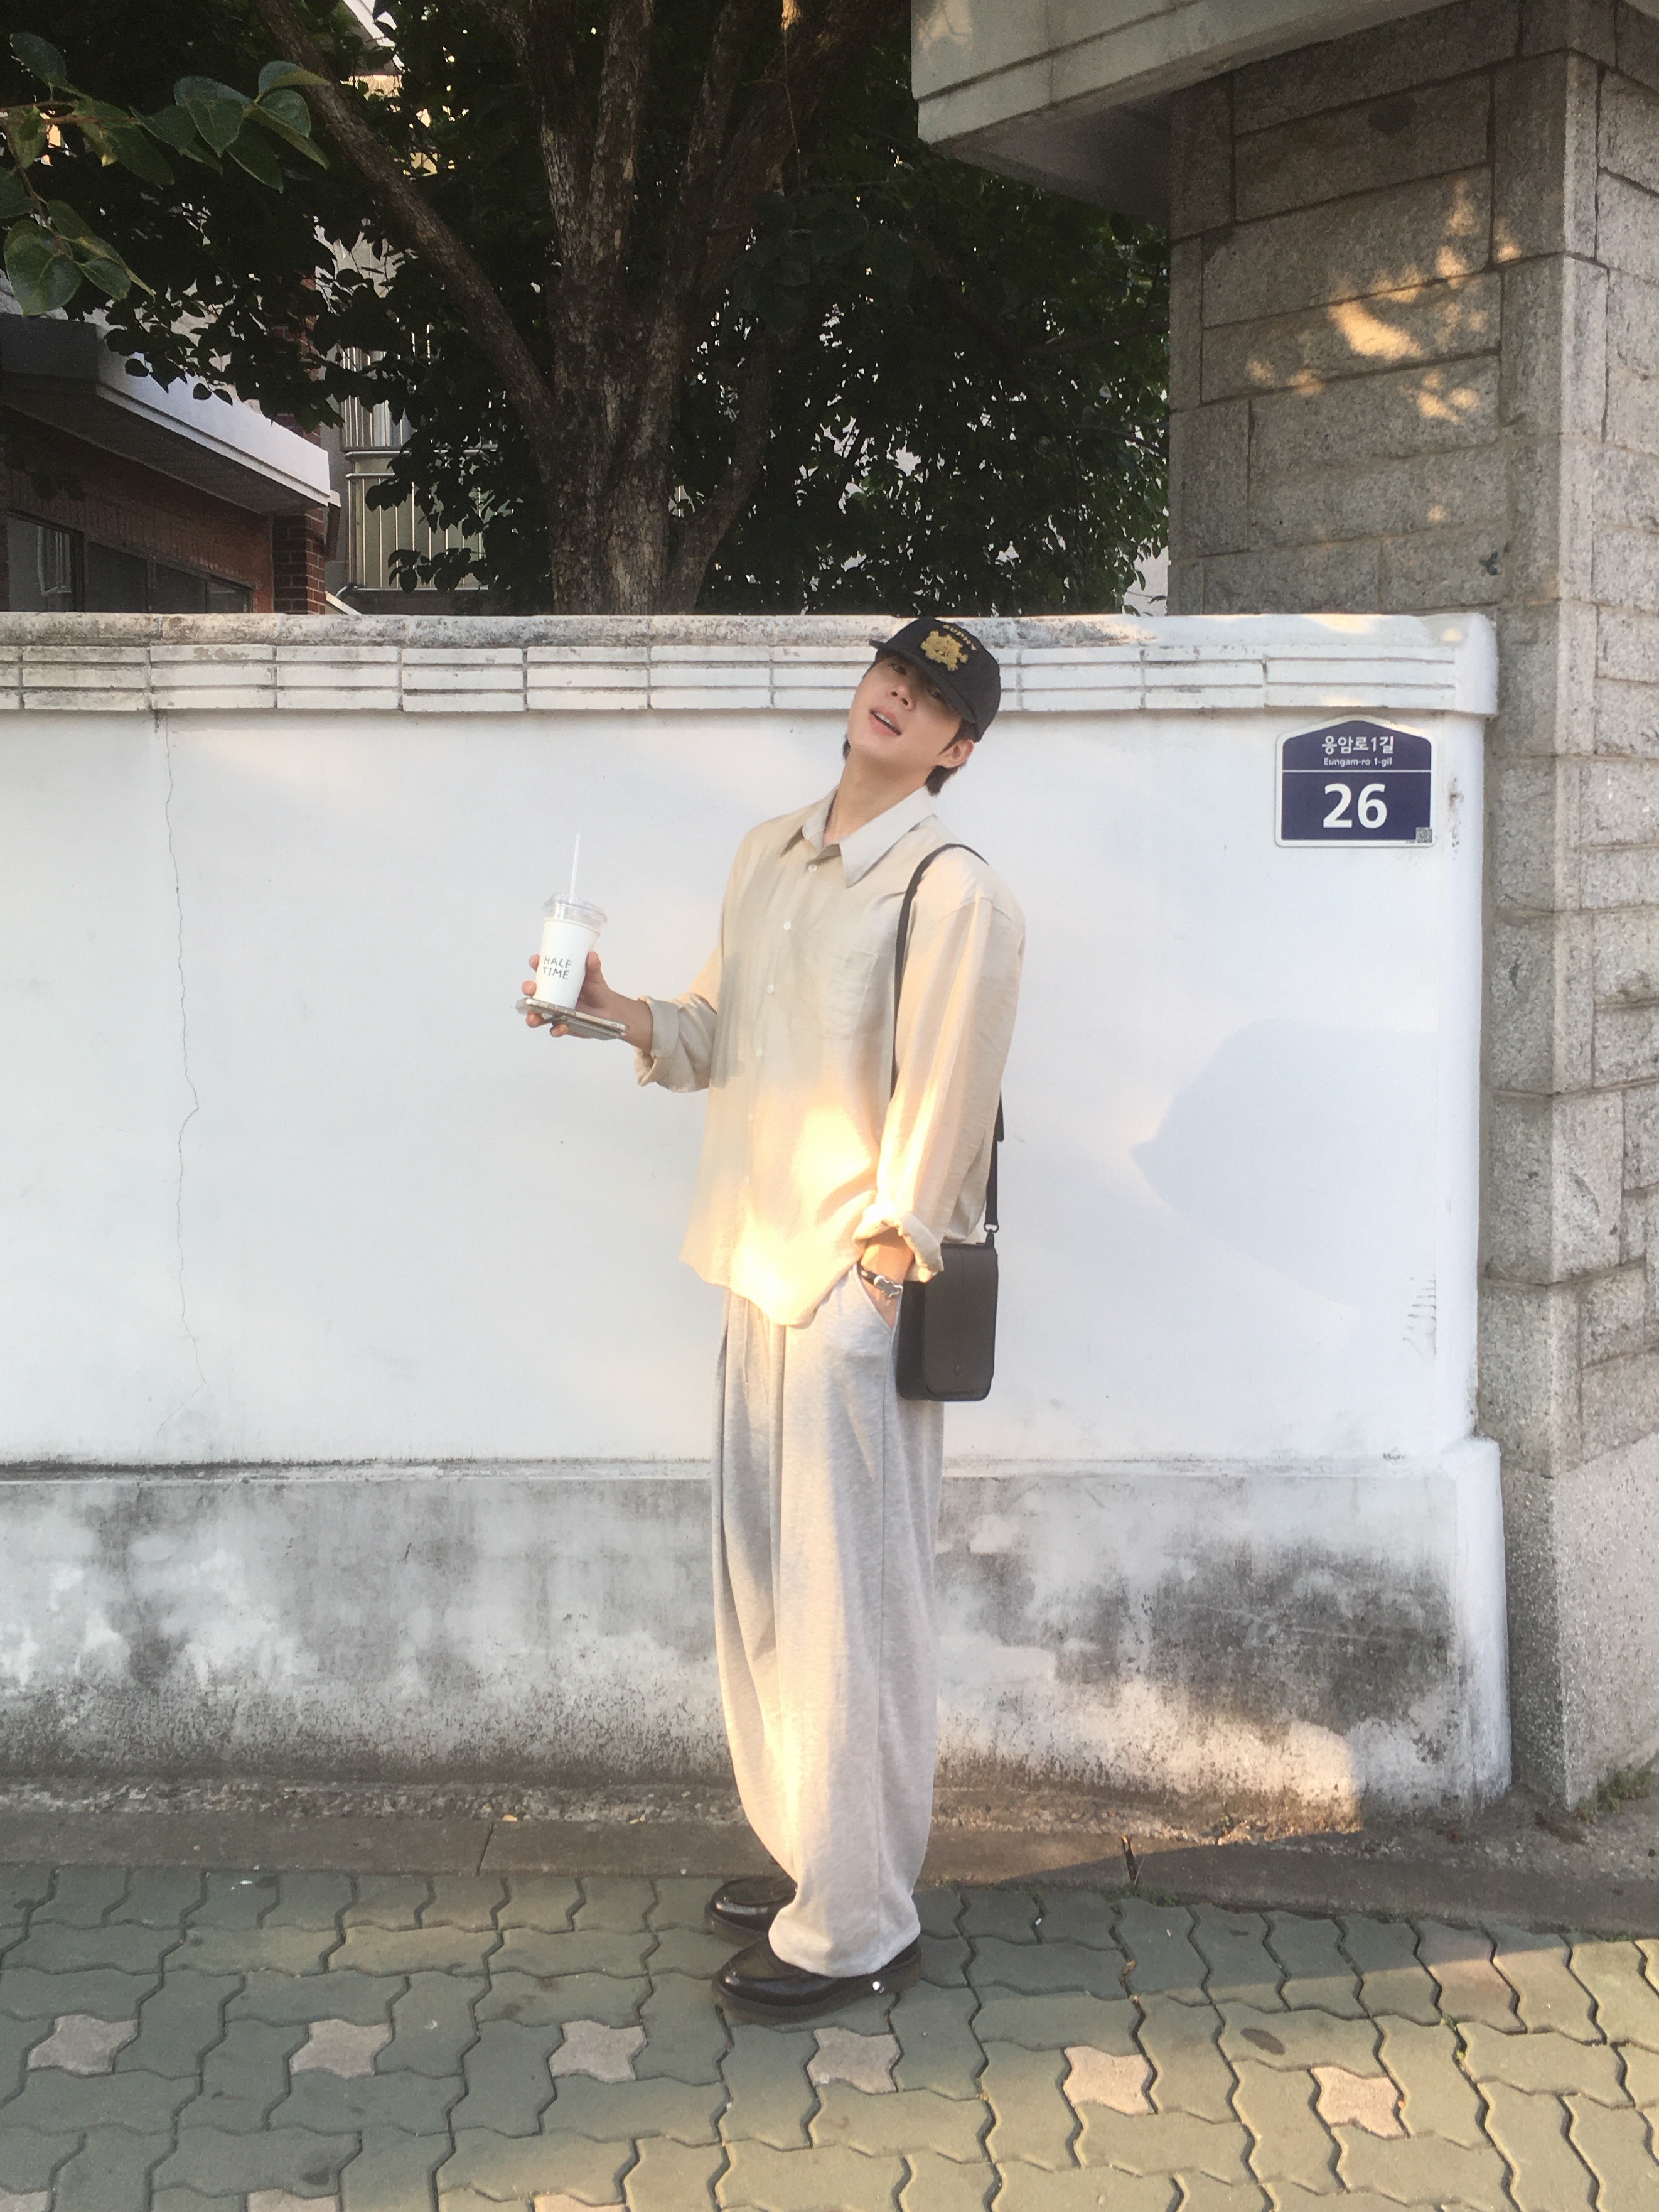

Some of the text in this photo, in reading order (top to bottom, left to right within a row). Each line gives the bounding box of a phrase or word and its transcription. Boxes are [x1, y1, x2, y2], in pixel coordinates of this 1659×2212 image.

[1321, 735, 1393, 755] 응암로1길
[1323, 757, 1393, 768] Eungam-ro 1-gil
[1323, 783, 1388, 829] 26
[544, 955, 572, 969] HALF
[543, 966, 569, 980] TIME
